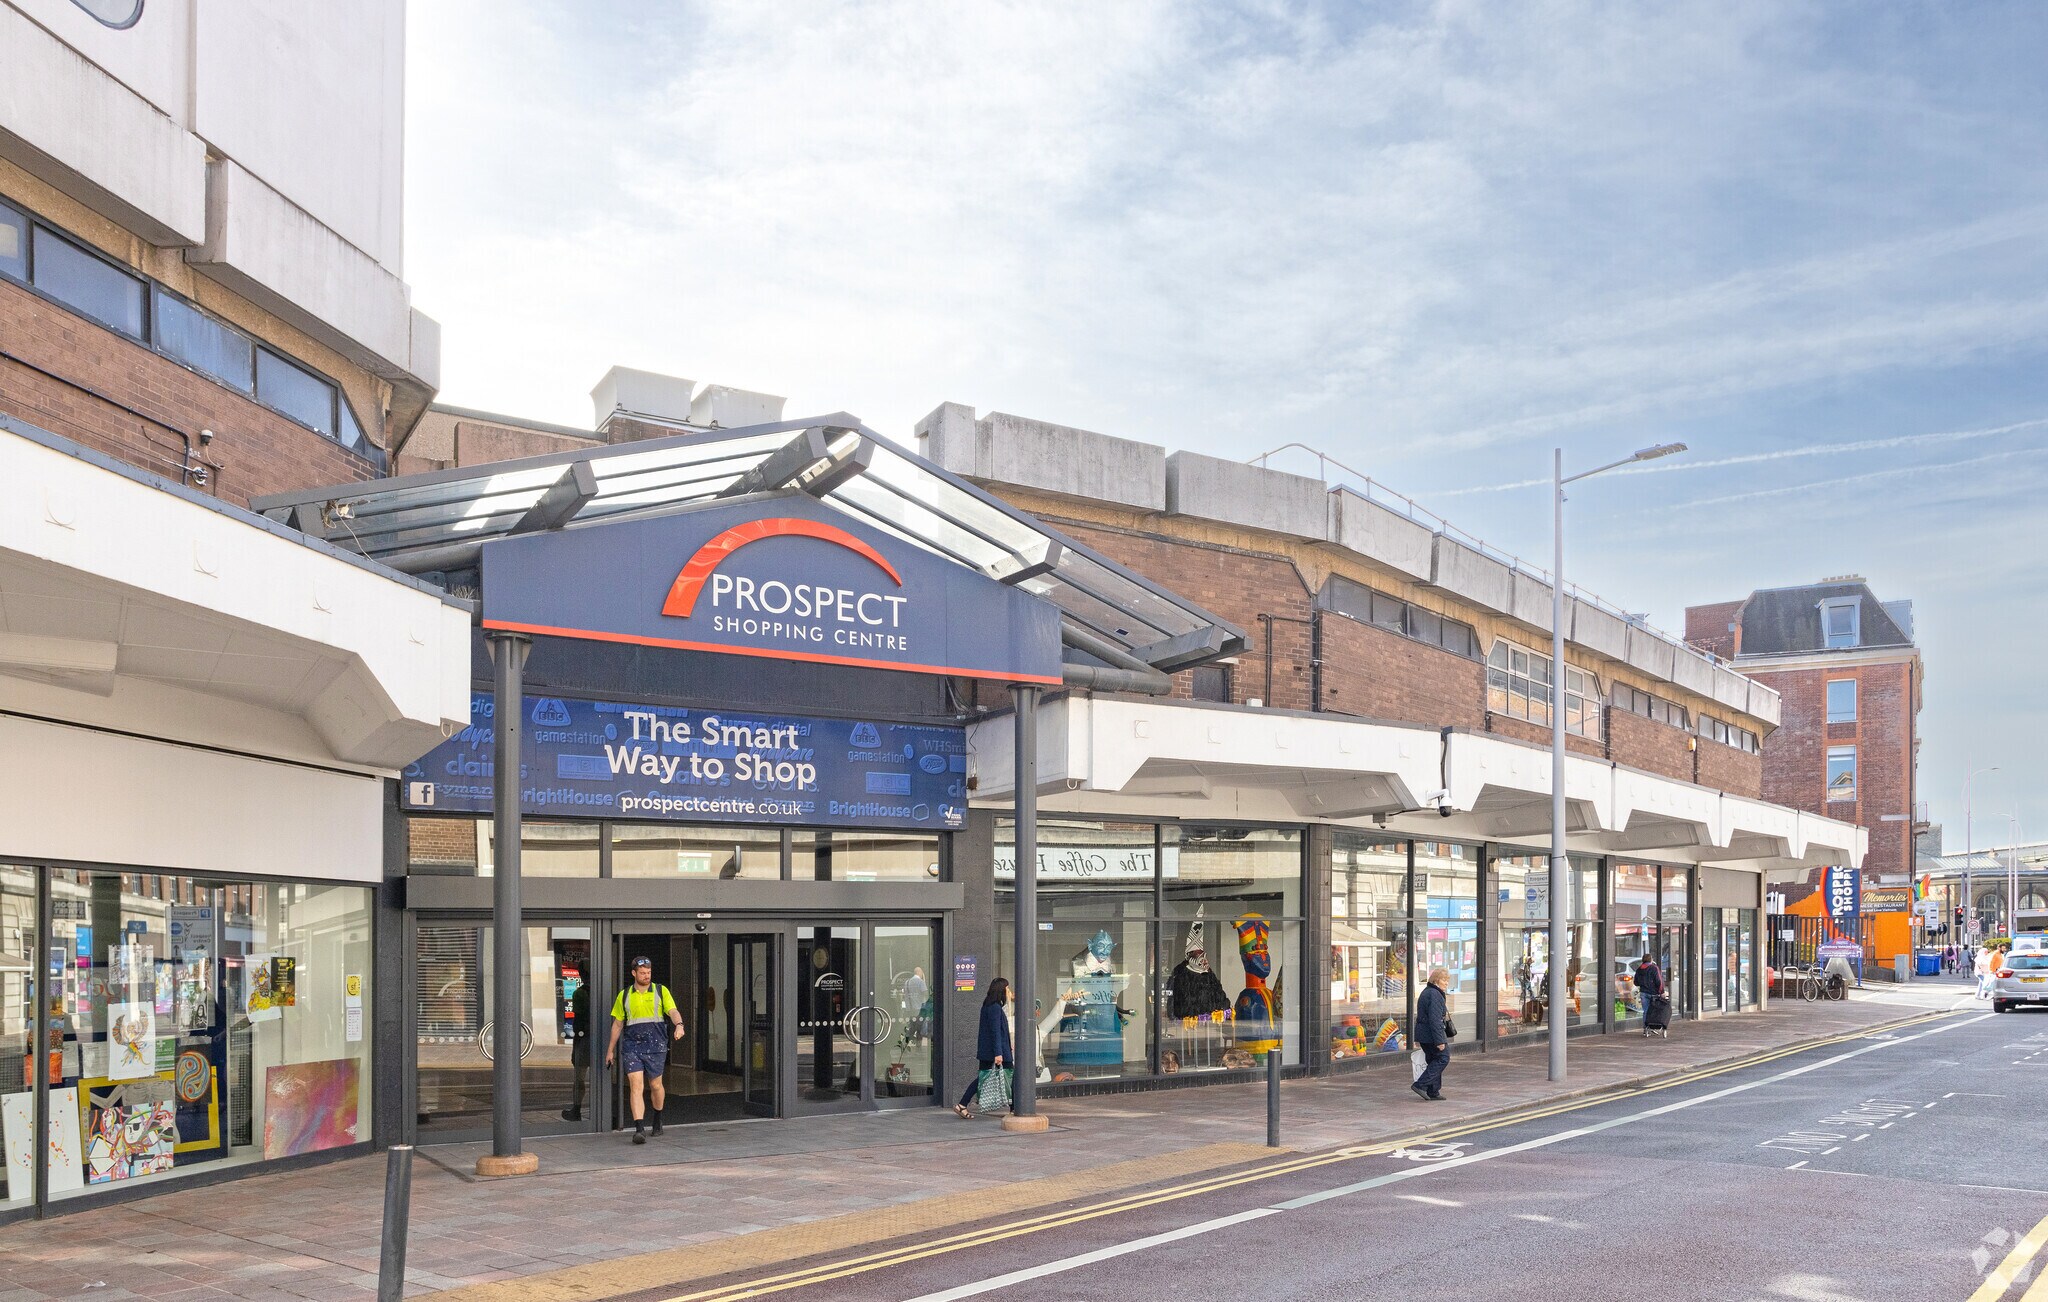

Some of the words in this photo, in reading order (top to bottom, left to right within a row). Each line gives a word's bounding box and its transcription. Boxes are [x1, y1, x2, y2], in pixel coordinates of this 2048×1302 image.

[711, 573, 907, 628] PROSPECT
[713, 616, 823, 642] SHOPPING
[834, 629, 907, 651] CENTRE
[535, 729, 606, 744] gamestation
[623, 711, 691, 744] The
[701, 716, 799, 750] Smart
[923, 739, 966, 752] WHSmi
[847, 749, 905, 764] gamestation
[604, 744, 681, 785] Way
[690, 752, 724, 779] to
[734, 752, 816, 790] Shop
[521, 787, 613, 806] rightHouse
[621, 795, 802, 816] prospectcentre.co.uk
[829, 800, 911, 818] BrightHouse
[1843, 869, 1853, 912] SHOPPI
[1863, 891, 1908, 903] Memories
